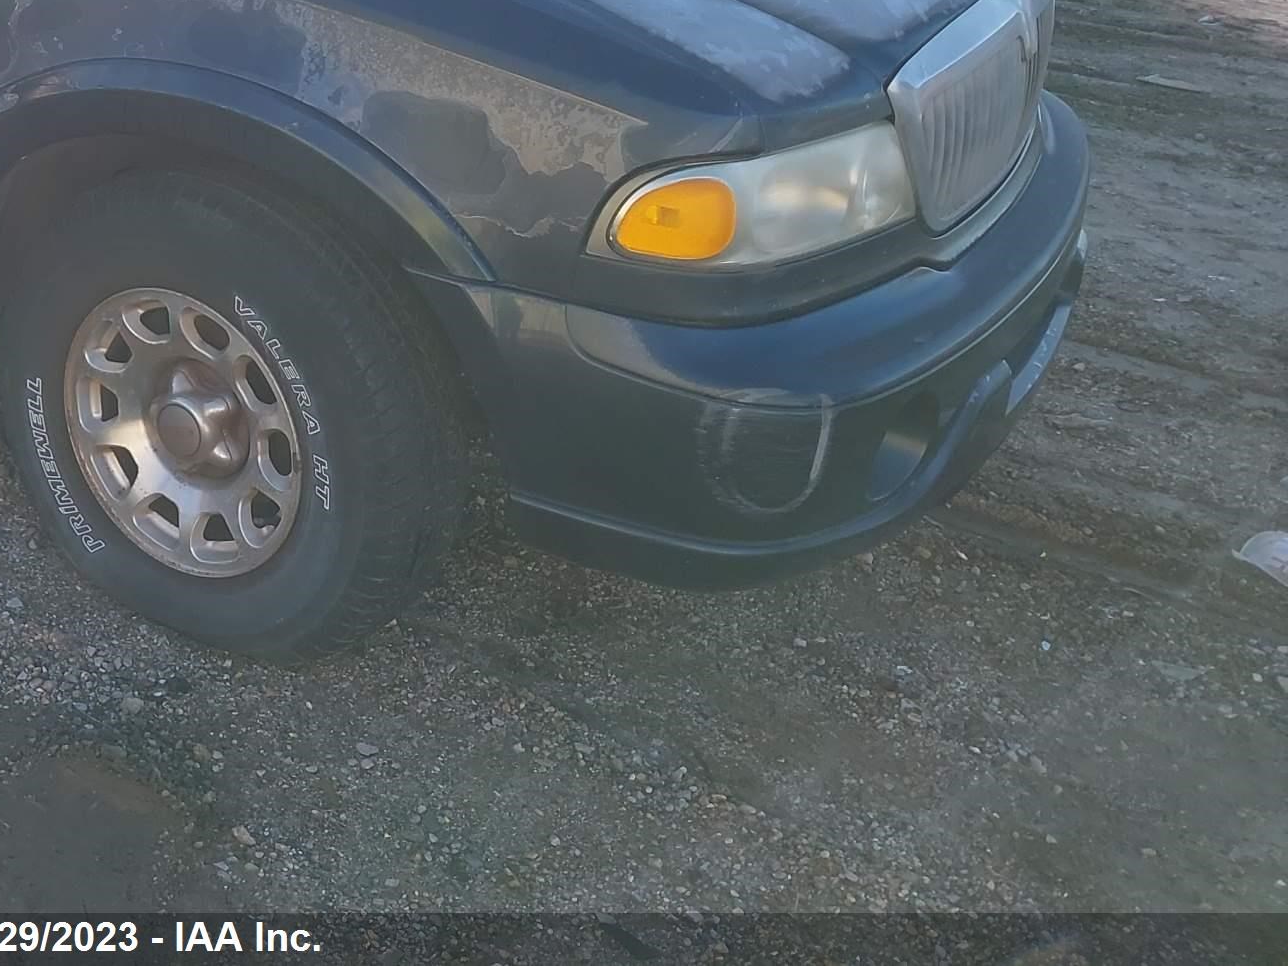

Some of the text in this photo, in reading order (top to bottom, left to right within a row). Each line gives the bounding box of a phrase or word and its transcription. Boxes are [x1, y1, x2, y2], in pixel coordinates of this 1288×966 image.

[26, 377, 105, 554] PRIMEWELL
[234, 295, 331, 511] VALERA HT
